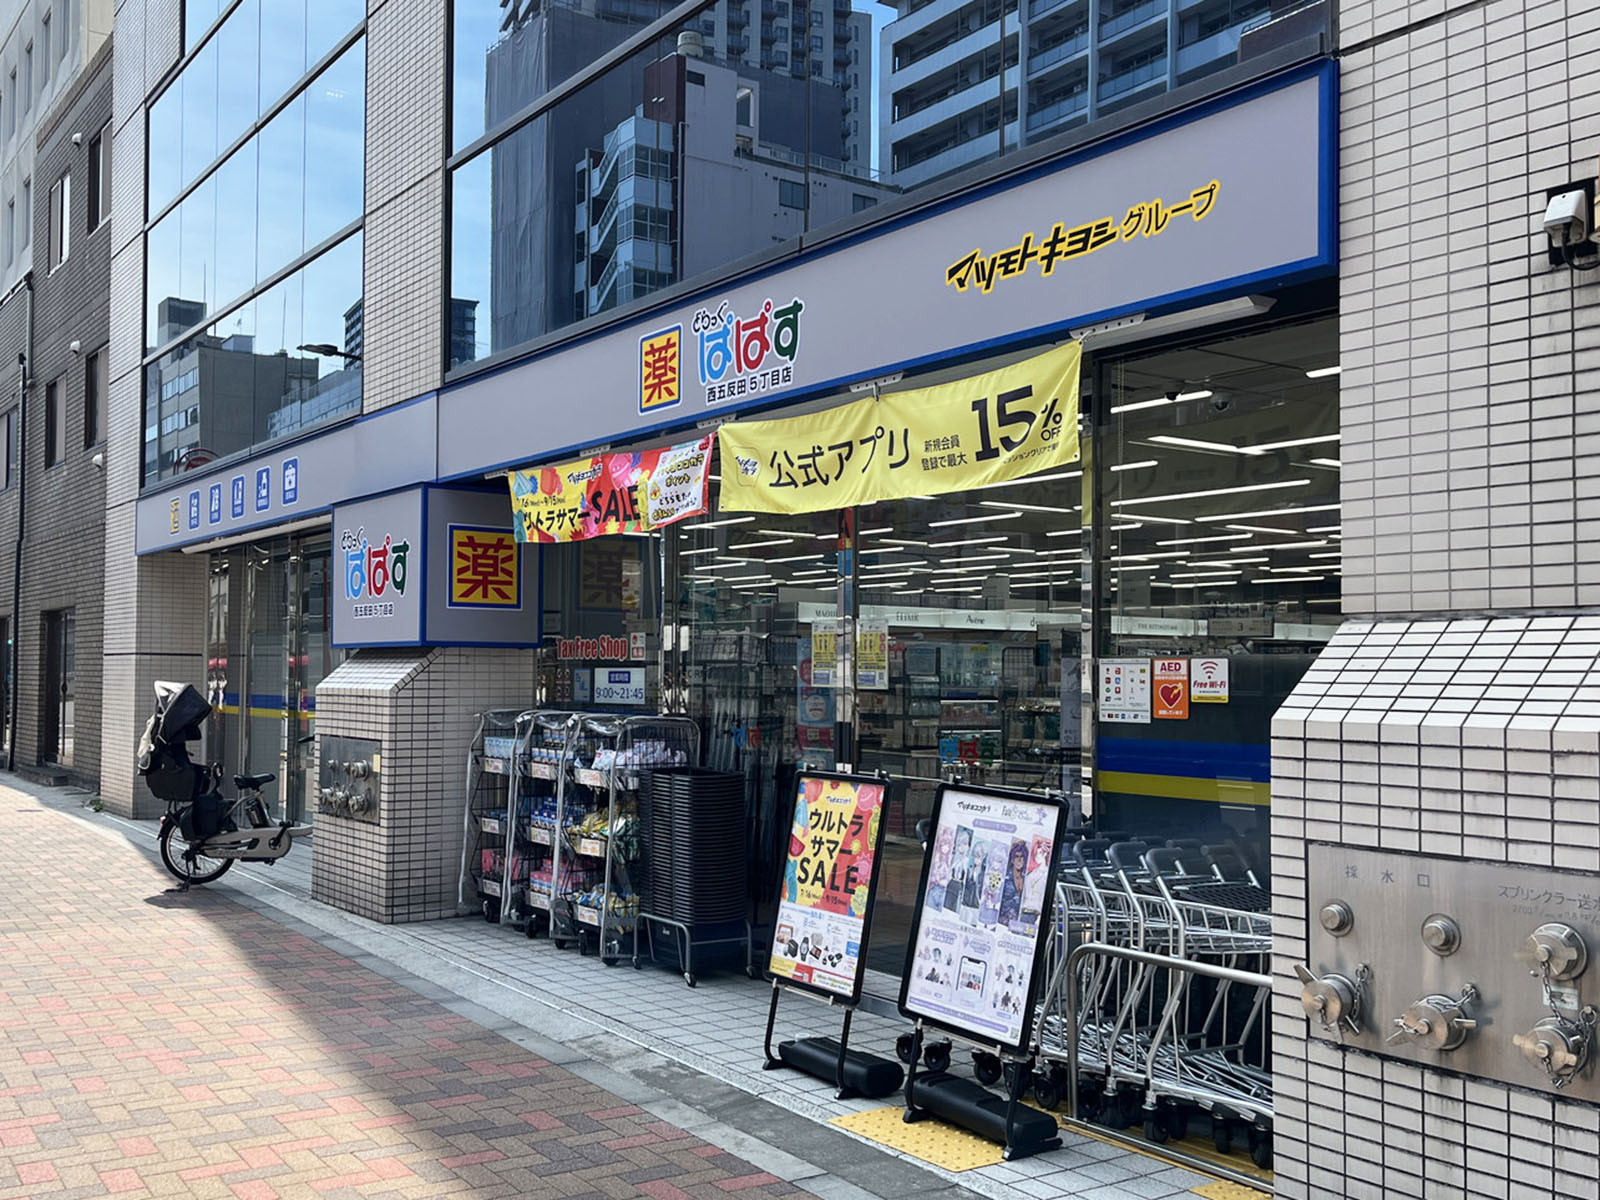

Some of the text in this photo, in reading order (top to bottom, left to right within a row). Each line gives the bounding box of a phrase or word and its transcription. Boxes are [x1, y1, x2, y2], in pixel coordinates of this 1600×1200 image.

[947, 181, 1219, 293] マツモトキヨシグループ
[699, 300, 803, 383] ぱぱす
[643, 337, 677, 404] 薬
[924, 434, 960, 453] 新規会員
[1041, 425, 1062, 441] OFF
[769, 424, 910, 490] 公式アプリ
[921, 452, 968, 471] 登録で最大
[592, 485, 641, 525] SALE
[345, 534, 409, 599] ぱぱす
[456, 535, 514, 600] 薬
[556, 635, 628, 661] Tax Free Shop
[1160, 662, 1182, 672] AED
[1193, 680, 1226, 689] Free Wi-Fi
[809, 808, 864, 837] ウルトラ
[811, 835, 853, 860] サマー
[797, 857, 859, 895] SALE
